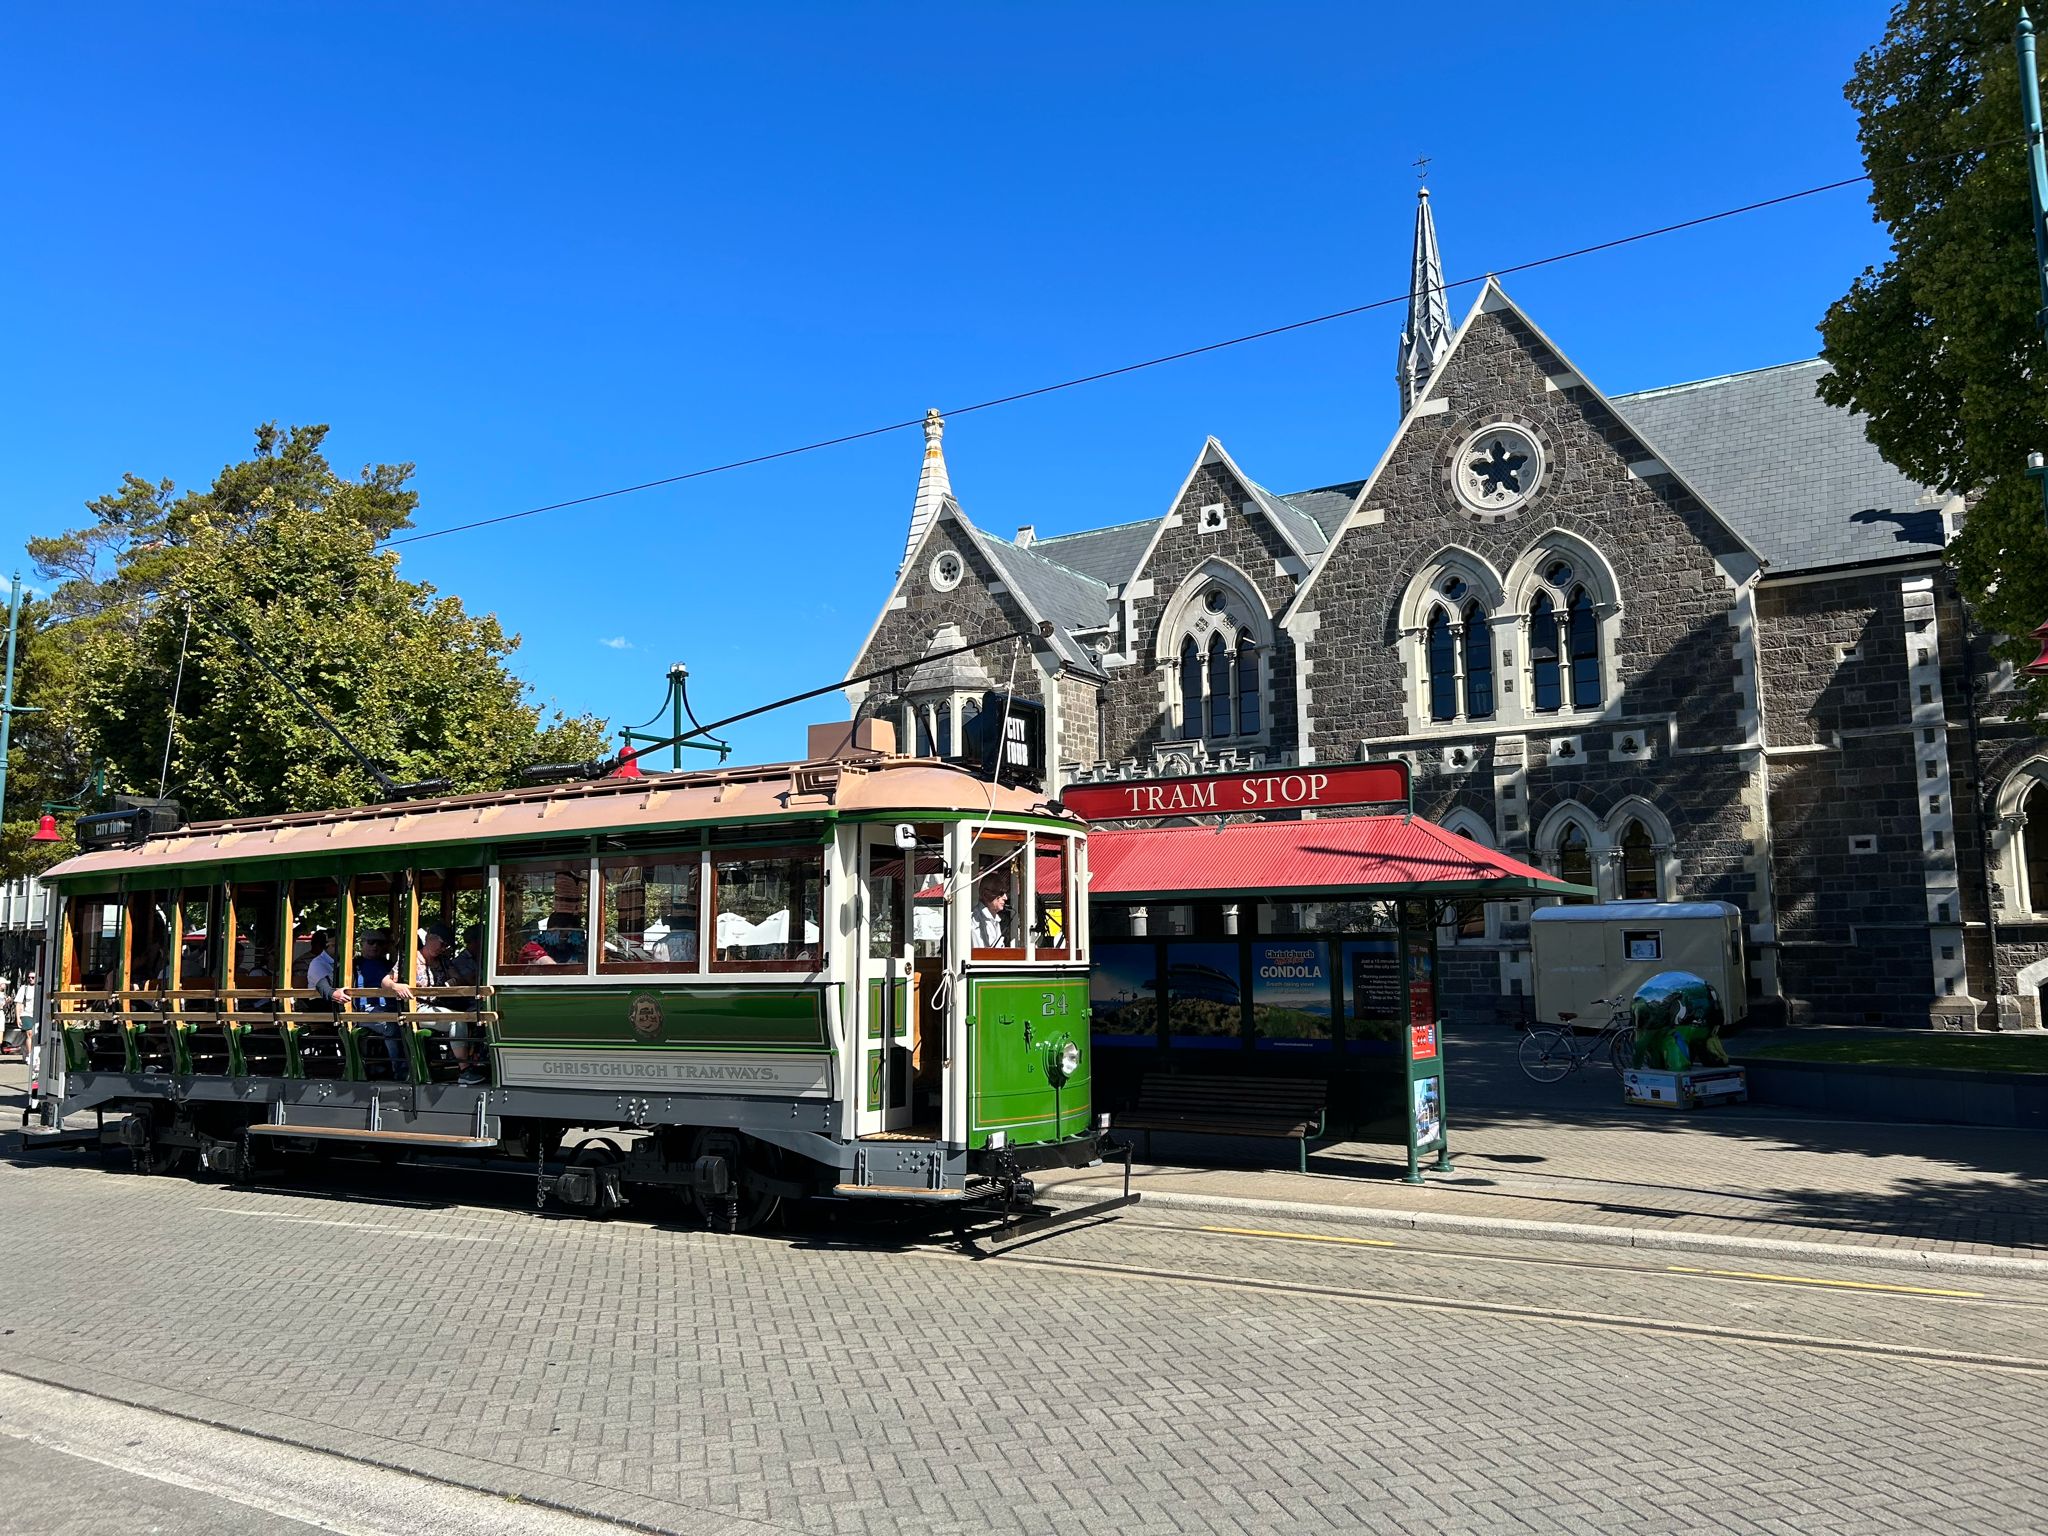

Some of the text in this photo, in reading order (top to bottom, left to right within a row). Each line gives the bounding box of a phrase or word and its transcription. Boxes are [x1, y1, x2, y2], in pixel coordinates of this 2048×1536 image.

[1006, 716, 1026, 742] CITY
[1006, 741, 1029, 767] TOUR
[1125, 774, 1329, 812] TRAM STOP
[95, 823, 109, 836] CITY
[1265, 949, 1315, 959] Christchurch
[1259, 965, 1322, 978] GONDOLA
[1041, 991, 1069, 1017] 24
[542, 1061, 780, 1081] CHRISTCHURCH TRAMWAYS.
